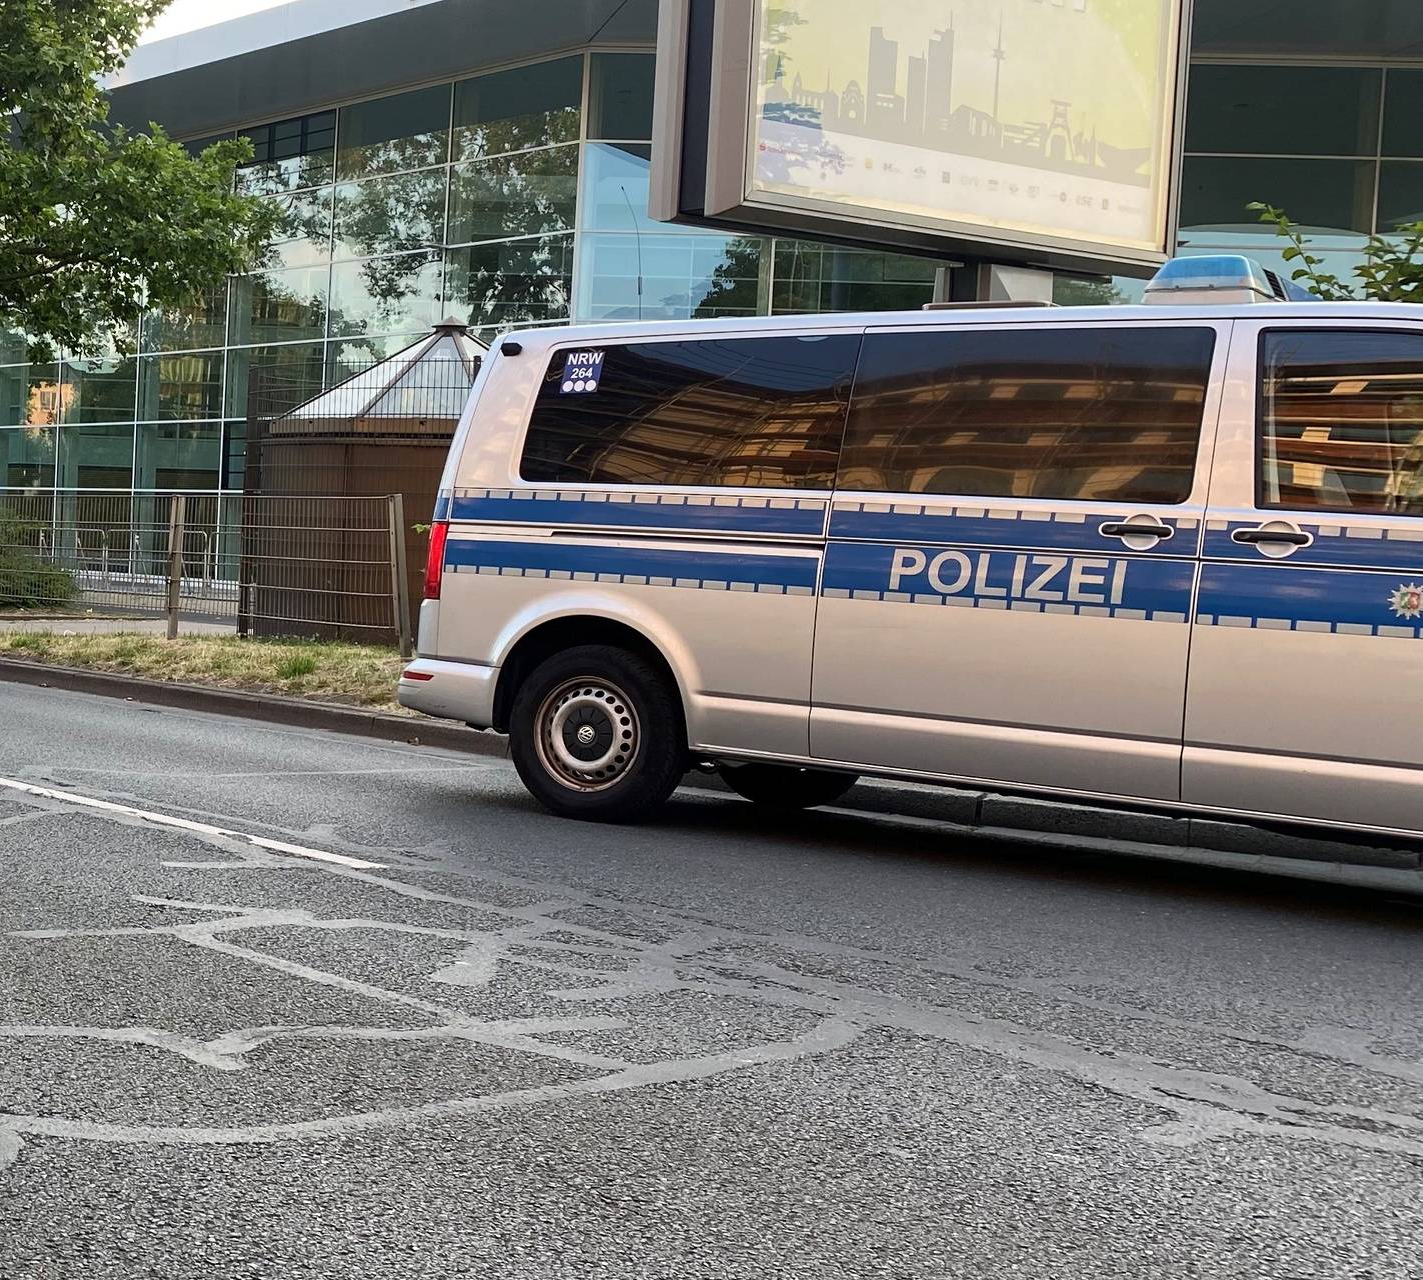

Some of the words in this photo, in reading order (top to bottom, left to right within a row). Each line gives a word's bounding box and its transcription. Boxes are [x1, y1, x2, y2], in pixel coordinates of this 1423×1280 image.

[567, 352, 604, 365] NRW
[570, 367, 593, 379] 264
[888, 548, 1128, 605] POLIZEI
